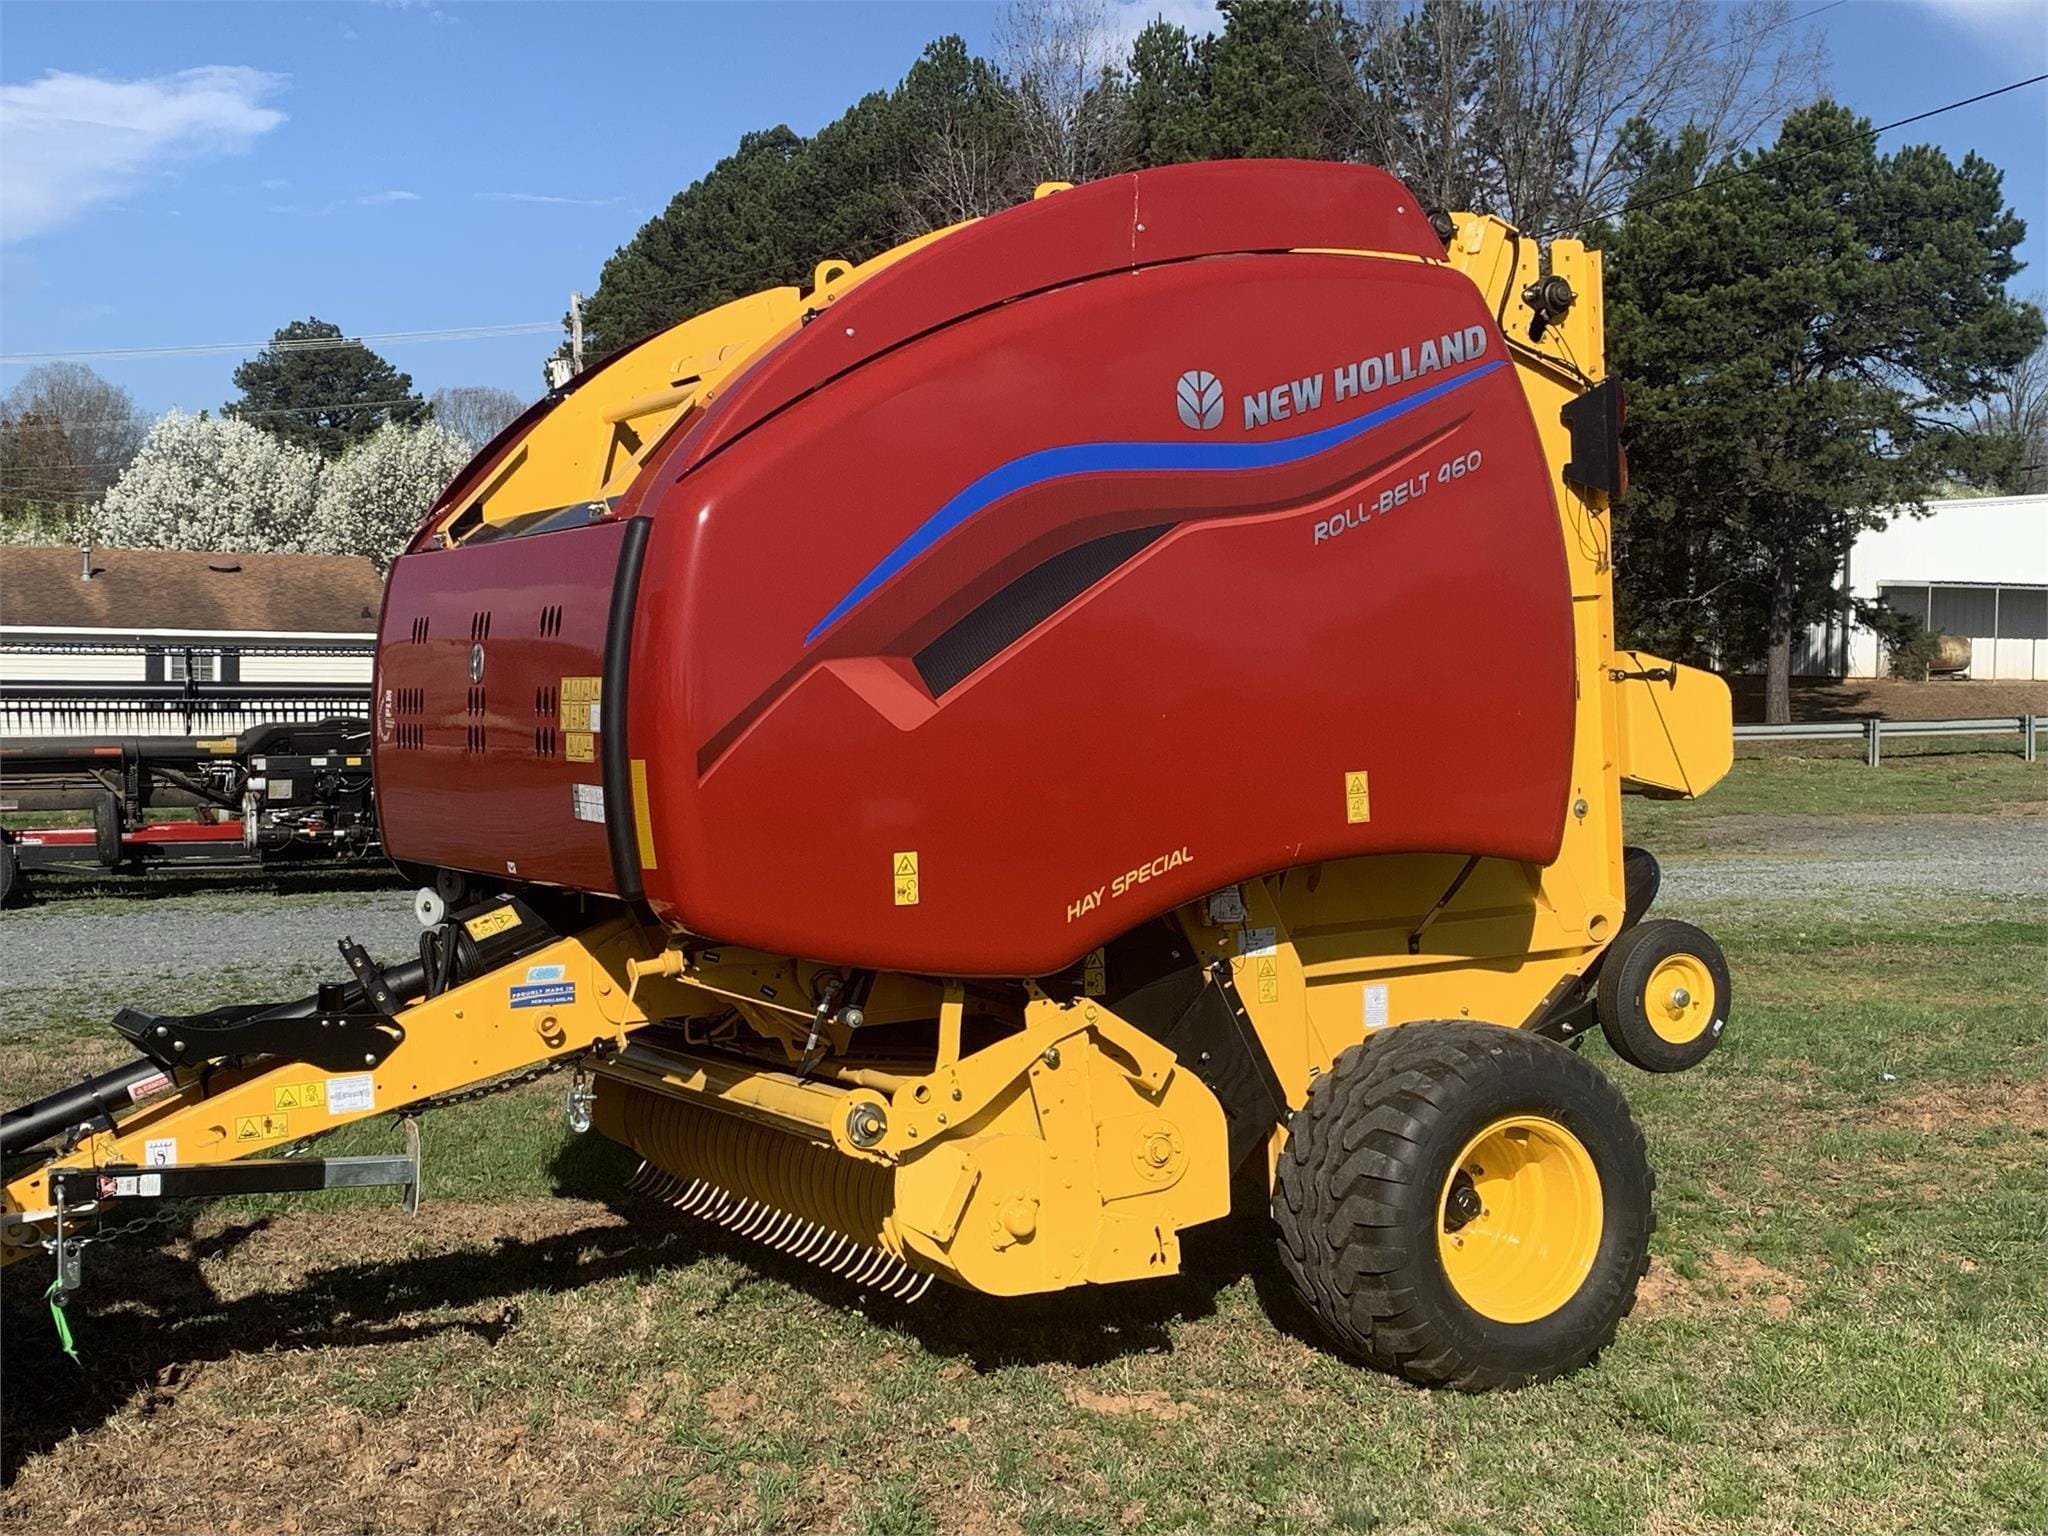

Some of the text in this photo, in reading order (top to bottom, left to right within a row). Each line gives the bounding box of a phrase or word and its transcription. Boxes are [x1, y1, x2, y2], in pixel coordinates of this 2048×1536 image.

[1242, 324, 1489, 431] NEW HOLLAND
[1313, 449, 1483, 546] ROLL-BELT 460
[1067, 846, 1194, 923] HAY SPECIAL
[512, 989, 543, 999] PROUDLY
